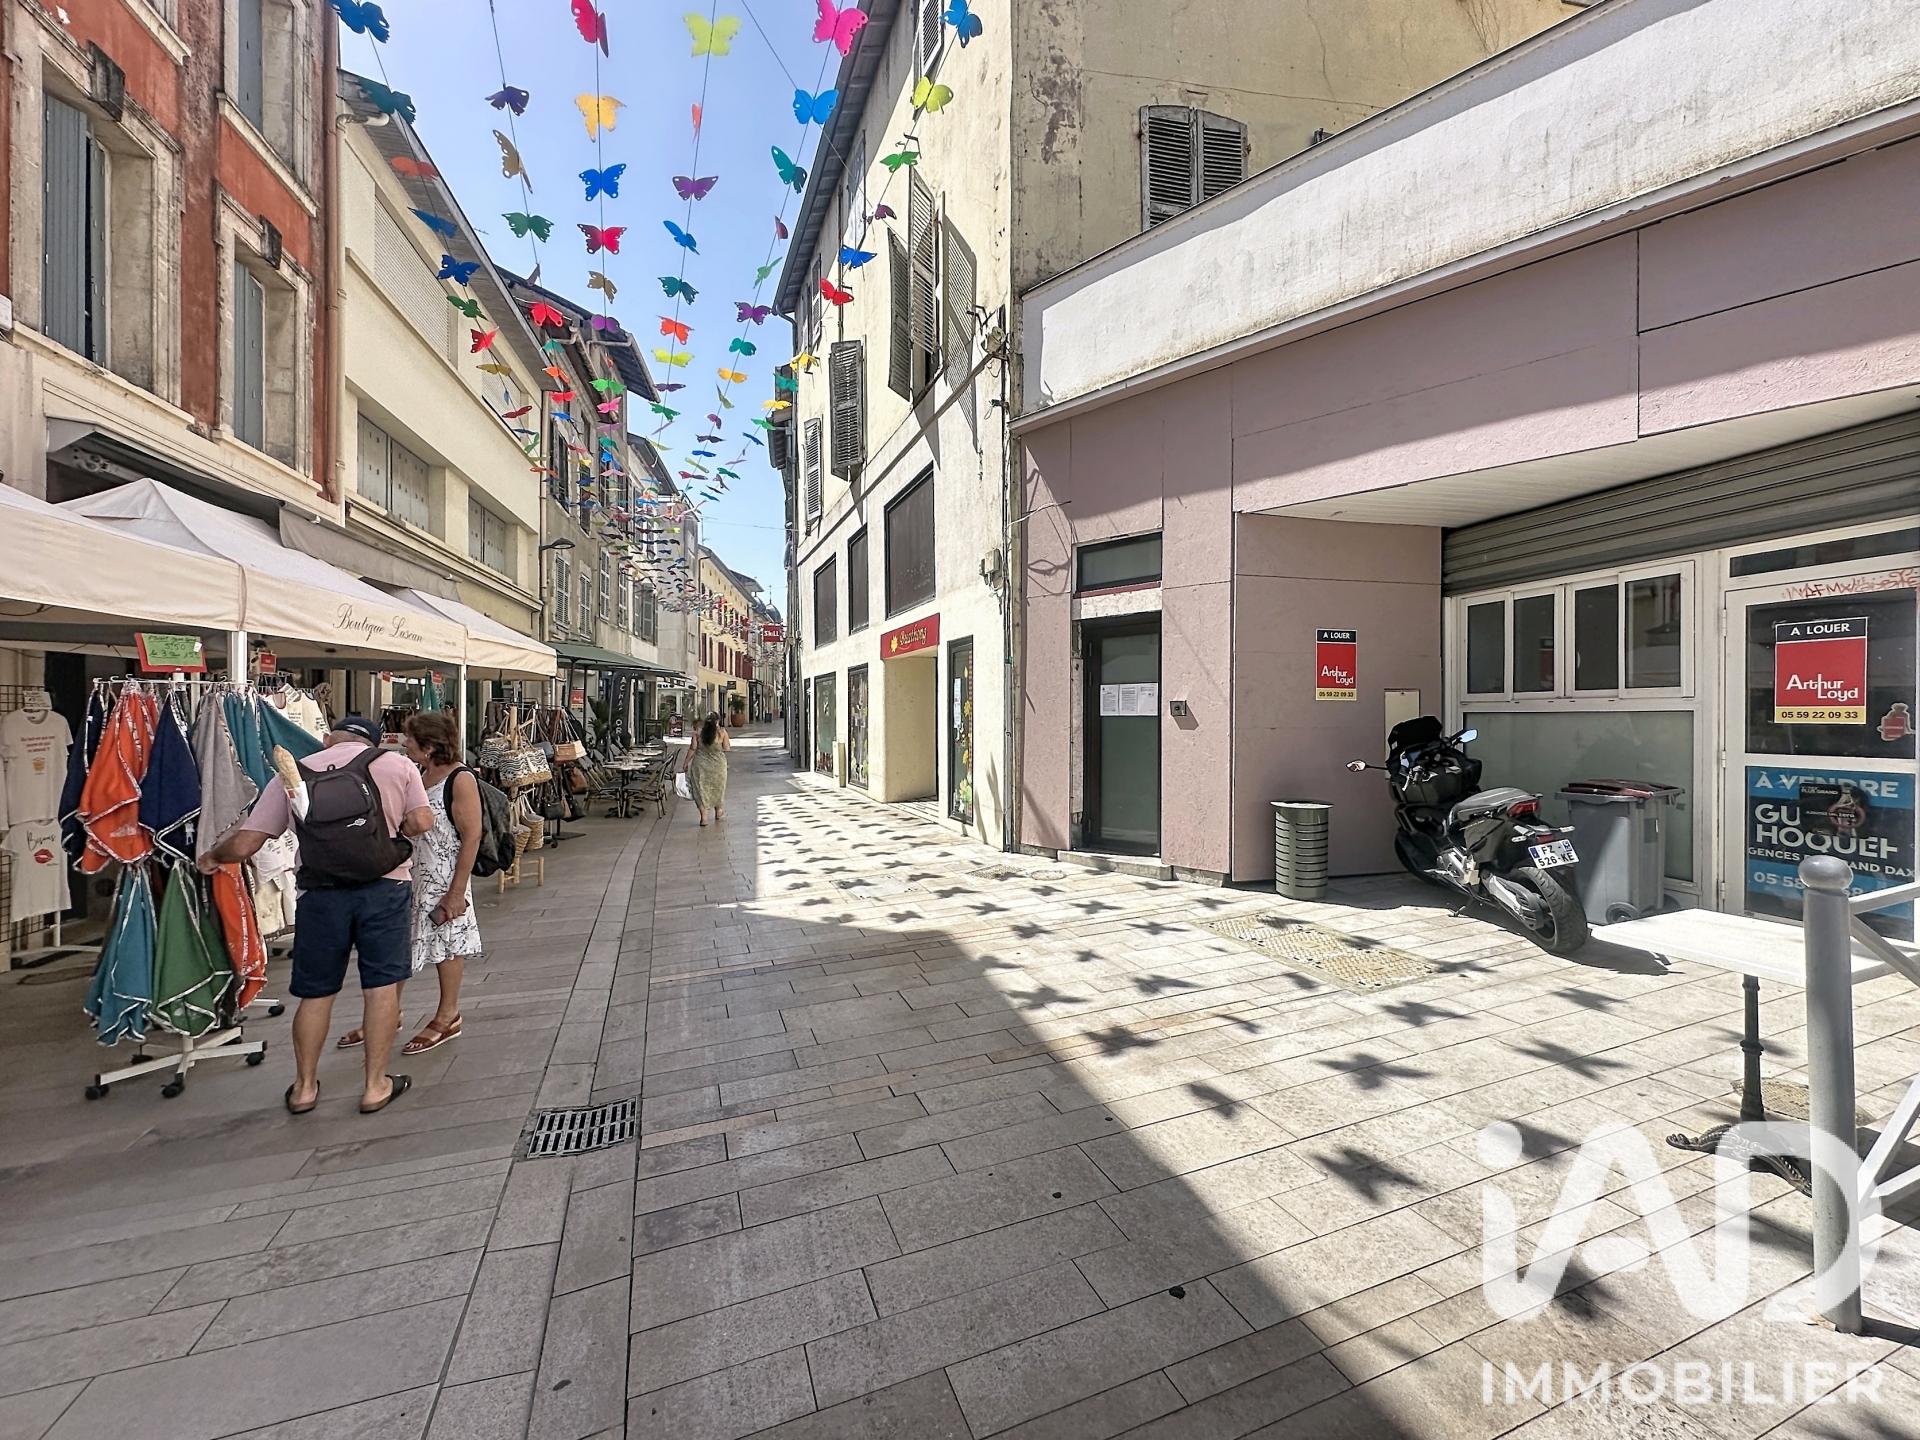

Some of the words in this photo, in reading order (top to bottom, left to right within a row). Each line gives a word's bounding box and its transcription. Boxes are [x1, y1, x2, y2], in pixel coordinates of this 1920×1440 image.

[333, 603, 385, 641] Boutique
[1790, 626, 1800, 636] A
[1806, 623, 1851, 635] LOUER
[1321, 666, 1347, 676] Arthur
[1786, 674, 1844, 690] Arthur
[1817, 686, 1858, 702] Loyd
[1781, 711, 1794, 719] 05
[1796, 711, 1809, 719] 59
[1812, 711, 1825, 719] 22
[1828, 711, 1841, 719] 09
[1844, 711, 1858, 719] 33
[1755, 771, 1773, 789] À
[1755, 804, 1801, 826] GU
[1748, 846, 1800, 861] GENCES
[1849, 858, 1881, 873] AND
[1754, 871, 1777, 886] 05
